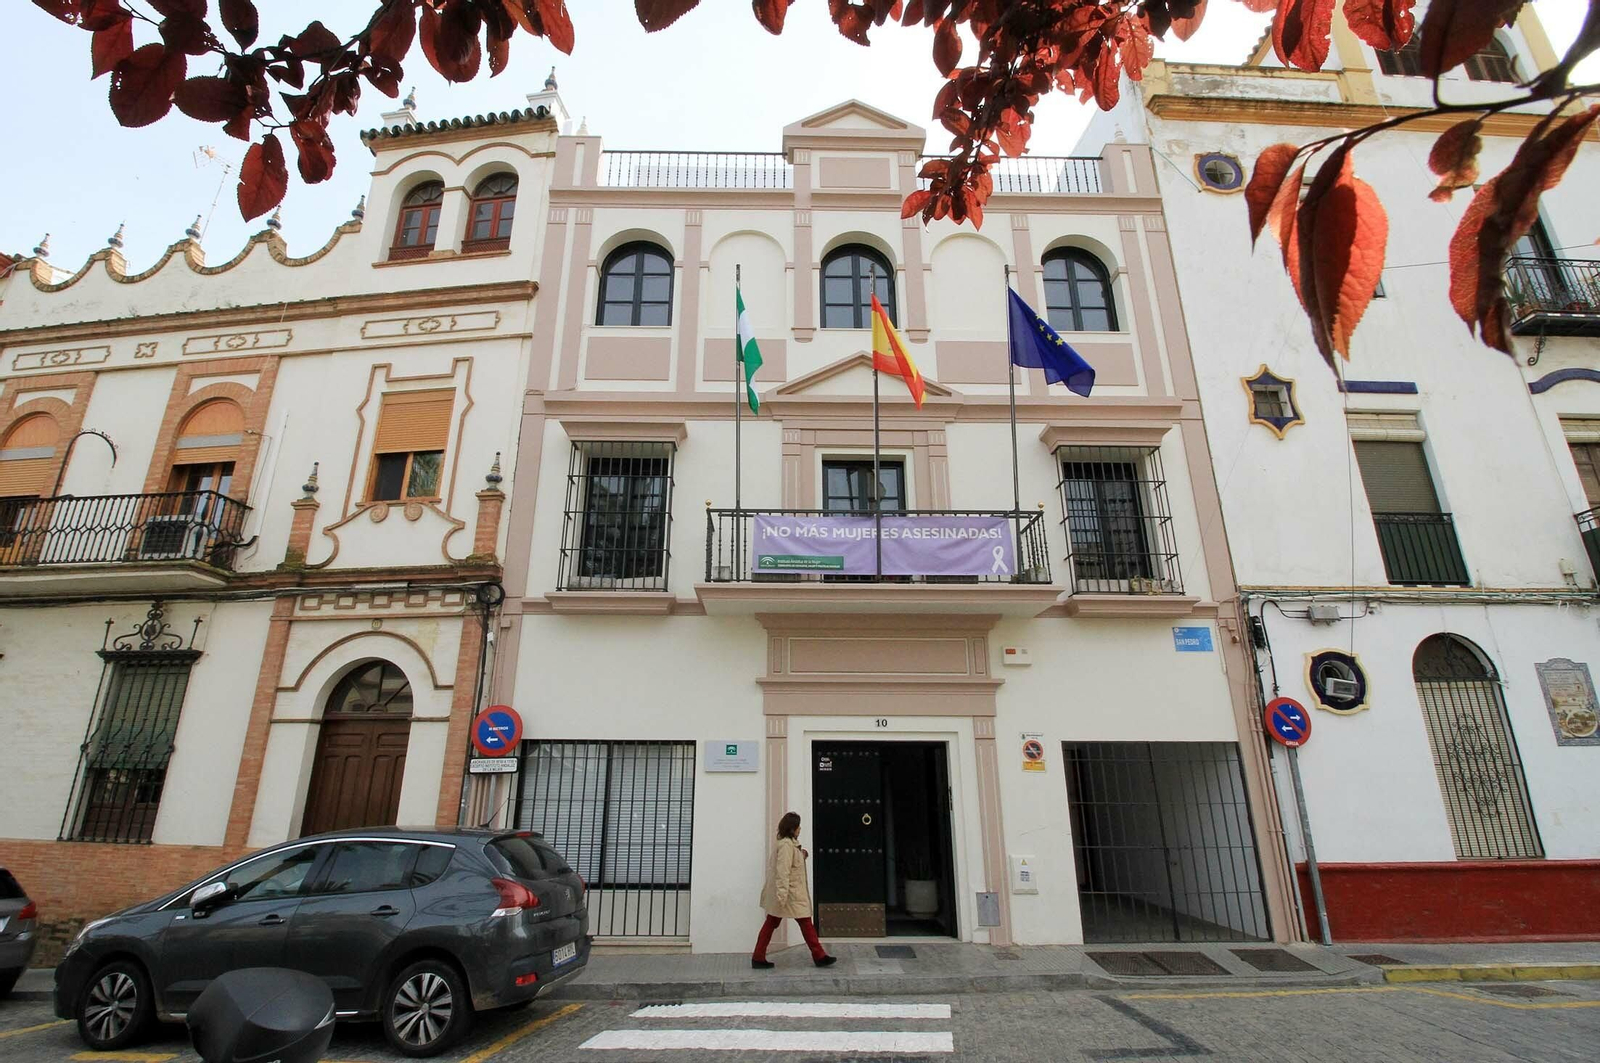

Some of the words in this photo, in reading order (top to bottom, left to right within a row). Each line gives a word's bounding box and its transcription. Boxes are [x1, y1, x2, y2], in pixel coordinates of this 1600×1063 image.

[762, 526, 791, 540] ¡NO
[795, 523, 828, 538] MÁS
[901, 526, 1002, 540] ASESINADAS!
[1184, 638, 1200, 646] PEDRO
[875, 719, 888, 728] 10
